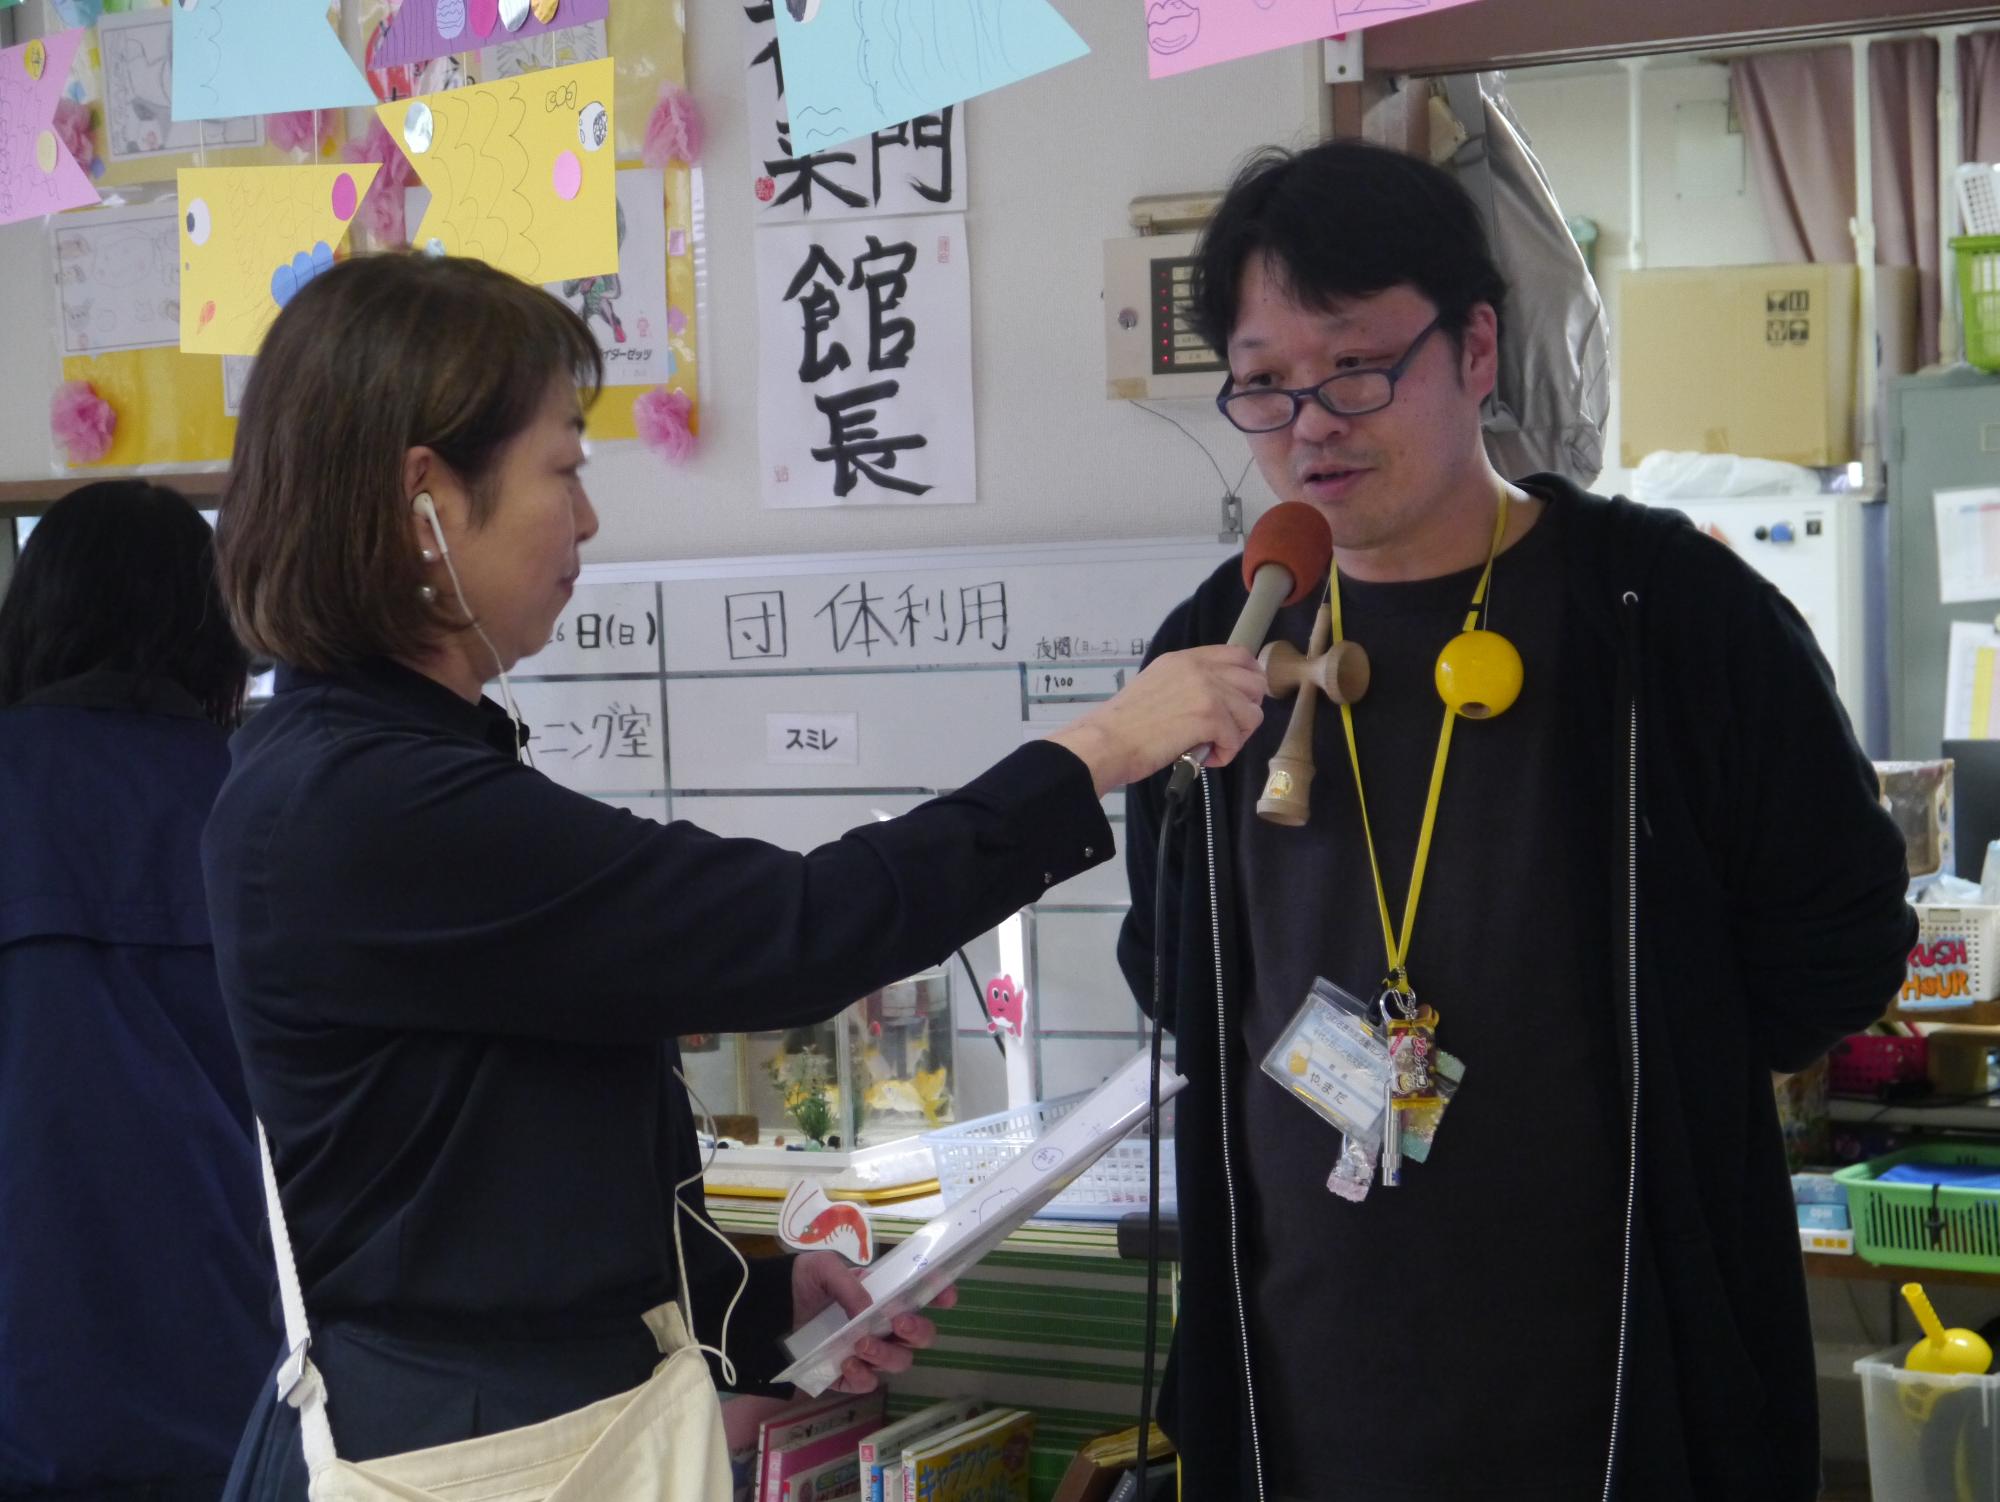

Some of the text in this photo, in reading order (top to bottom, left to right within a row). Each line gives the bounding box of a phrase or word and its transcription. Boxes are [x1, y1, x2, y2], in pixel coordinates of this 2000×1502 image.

[783, 235, 935, 497] 館長
[725, 581, 1009, 660] 団体利用
[786, 728, 838, 751] スミレ
[1309, 1071, 1350, 1105] やまだ
